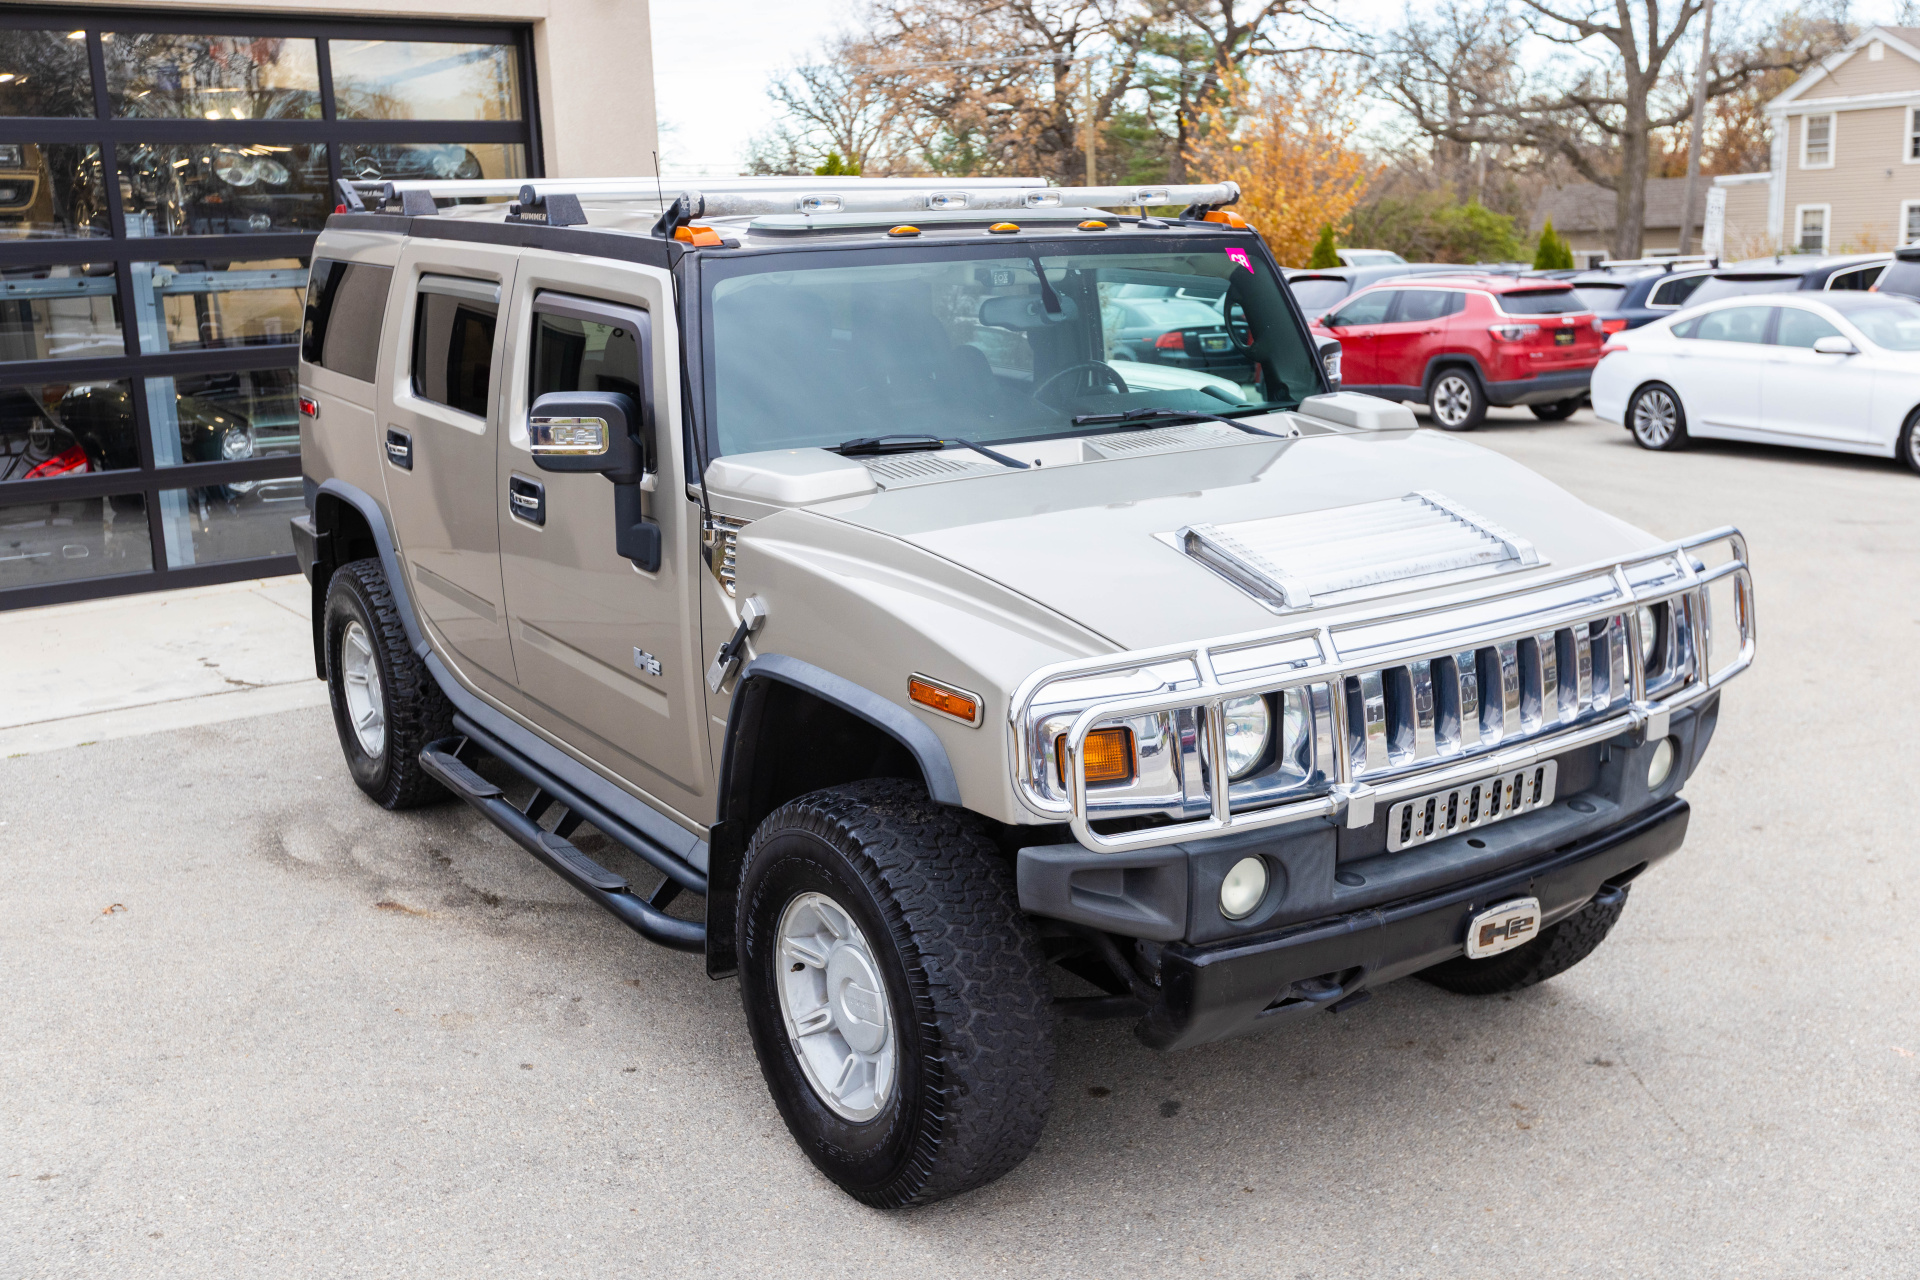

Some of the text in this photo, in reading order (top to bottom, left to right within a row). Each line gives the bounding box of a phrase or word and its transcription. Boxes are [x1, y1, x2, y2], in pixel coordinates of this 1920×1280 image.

[520, 212, 547, 222] HUMMER
[554, 427, 598, 445] H2
[633, 646, 662, 677] H2
[1365, 655, 1593, 725] HUMMER
[1479, 916, 1534, 947] H2
